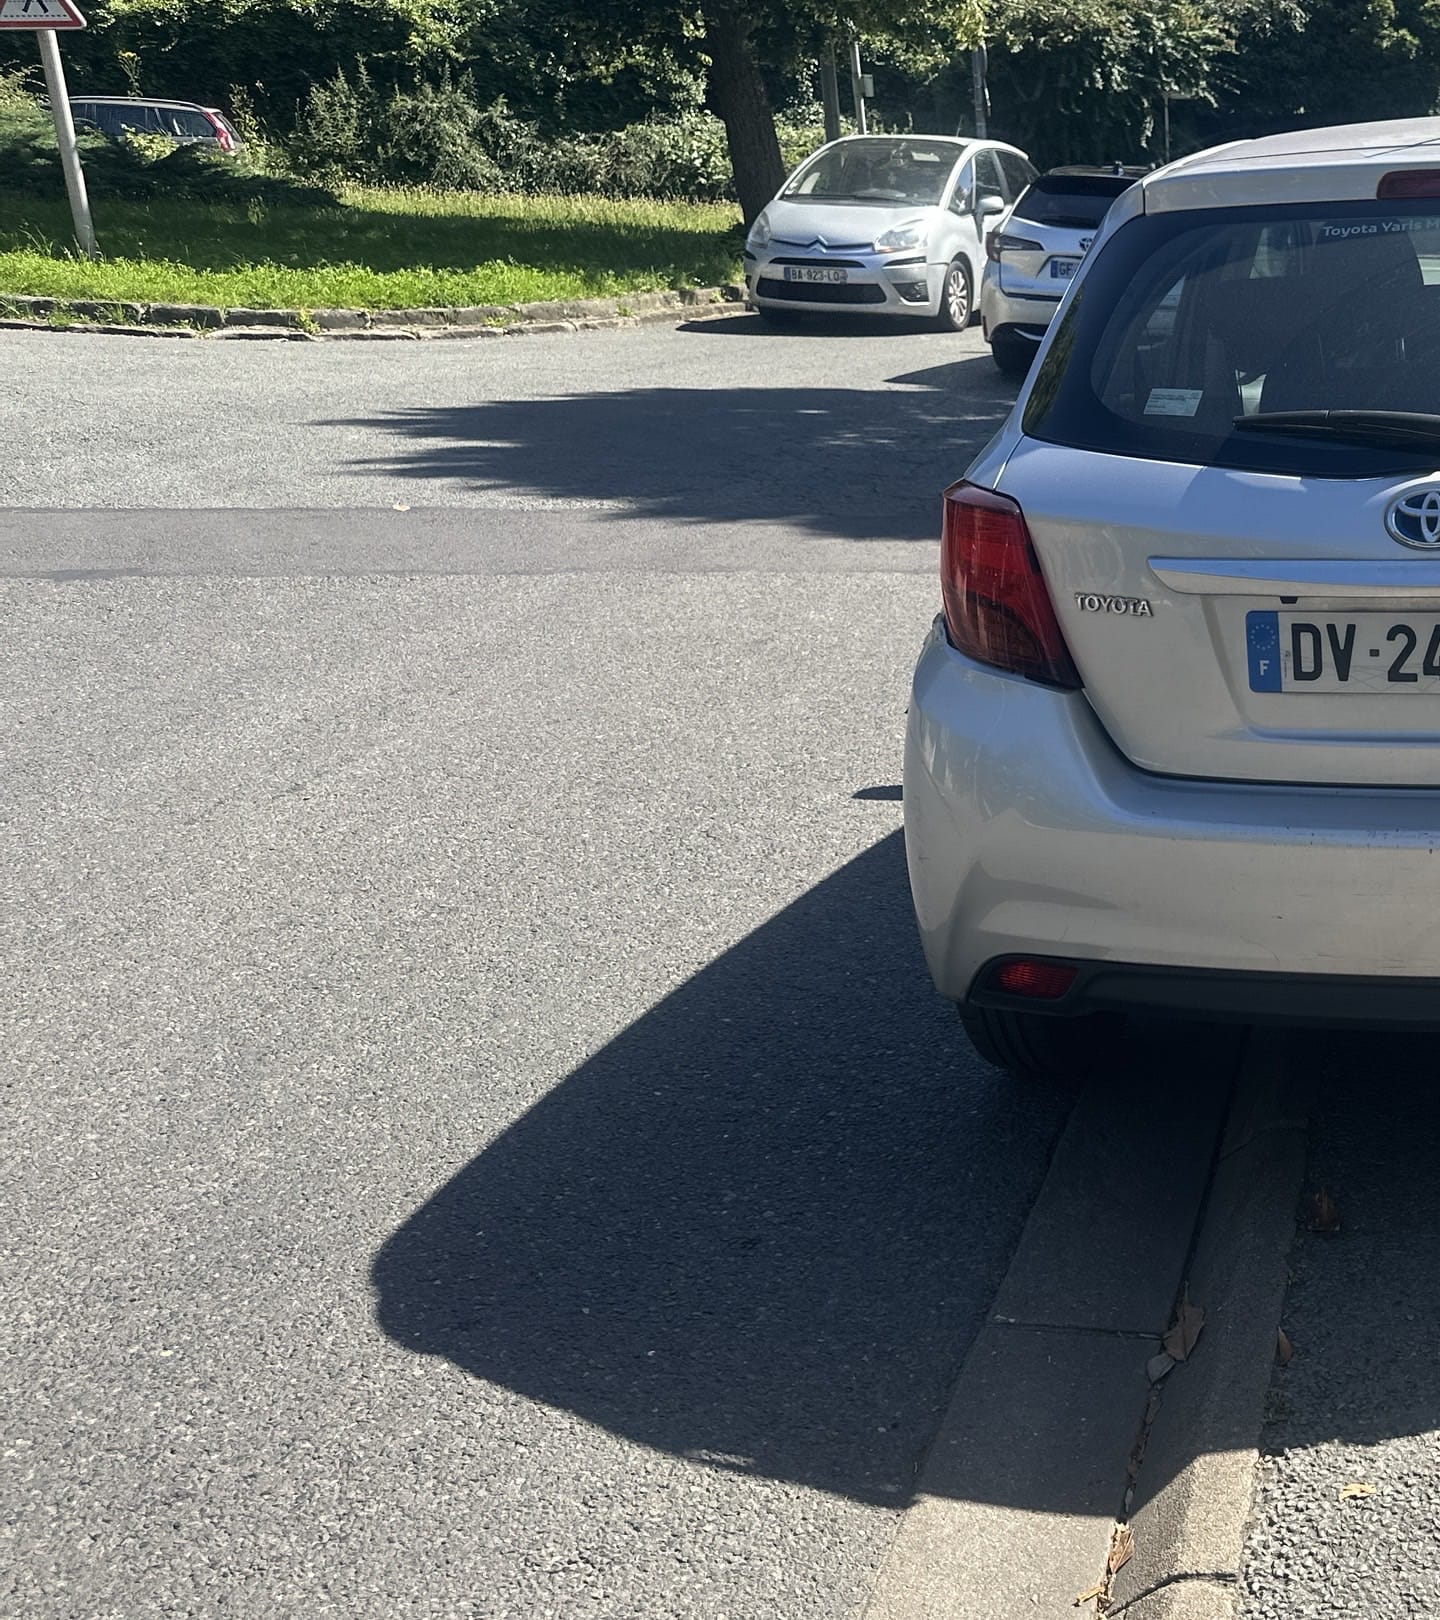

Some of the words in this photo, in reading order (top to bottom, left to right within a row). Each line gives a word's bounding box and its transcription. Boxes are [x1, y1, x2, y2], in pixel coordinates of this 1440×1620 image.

[1323, 224, 1378, 238] Toyota
[1382, 219, 1422, 232] Yaris
[1074, 592, 1154, 617] TOYOTA
[1260, 660, 1269, 676] F
